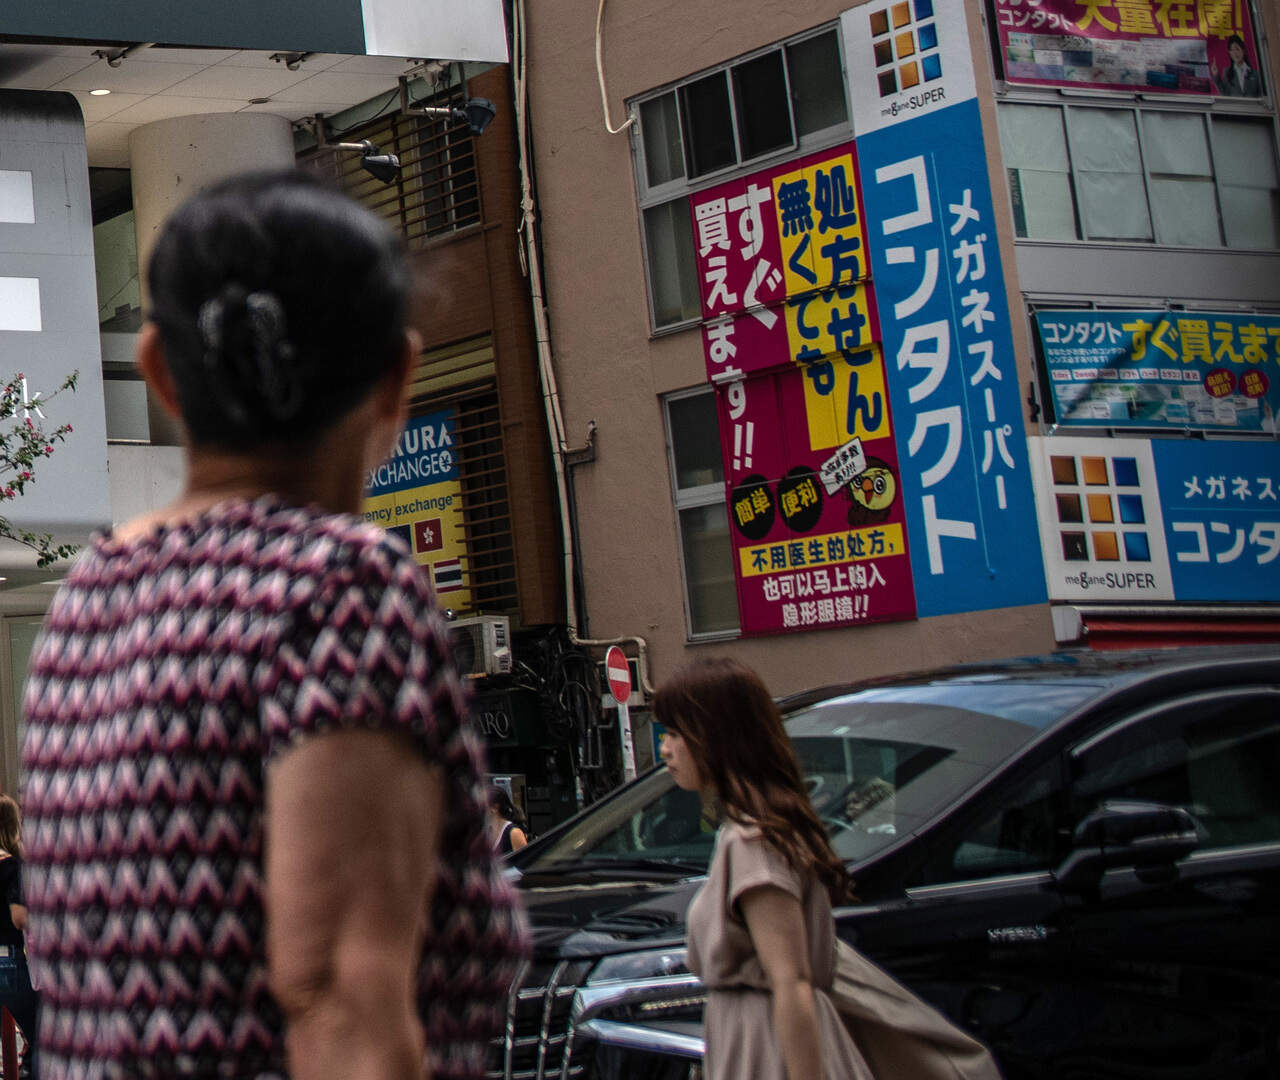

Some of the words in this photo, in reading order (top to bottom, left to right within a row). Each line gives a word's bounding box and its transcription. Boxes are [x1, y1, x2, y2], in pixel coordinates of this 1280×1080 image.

[999, 9, 1074, 31] コンタクト
[726, 182, 783, 331] すぐ
[777, 180, 837, 397] 無くても
[814, 163, 884, 437] 処方せん
[948, 187, 1017, 511] メガネスーパー
[1042, 320, 1124, 345] コンタクト
[874, 153, 979, 576] コンタクト
[395, 494, 453, 516] exchange
[734, 486, 772, 527] 簡単
[780, 476, 819, 519] 便利
[1183, 475, 1280, 501] メガネス
[761, 561, 888, 602] 也可以马上购入
